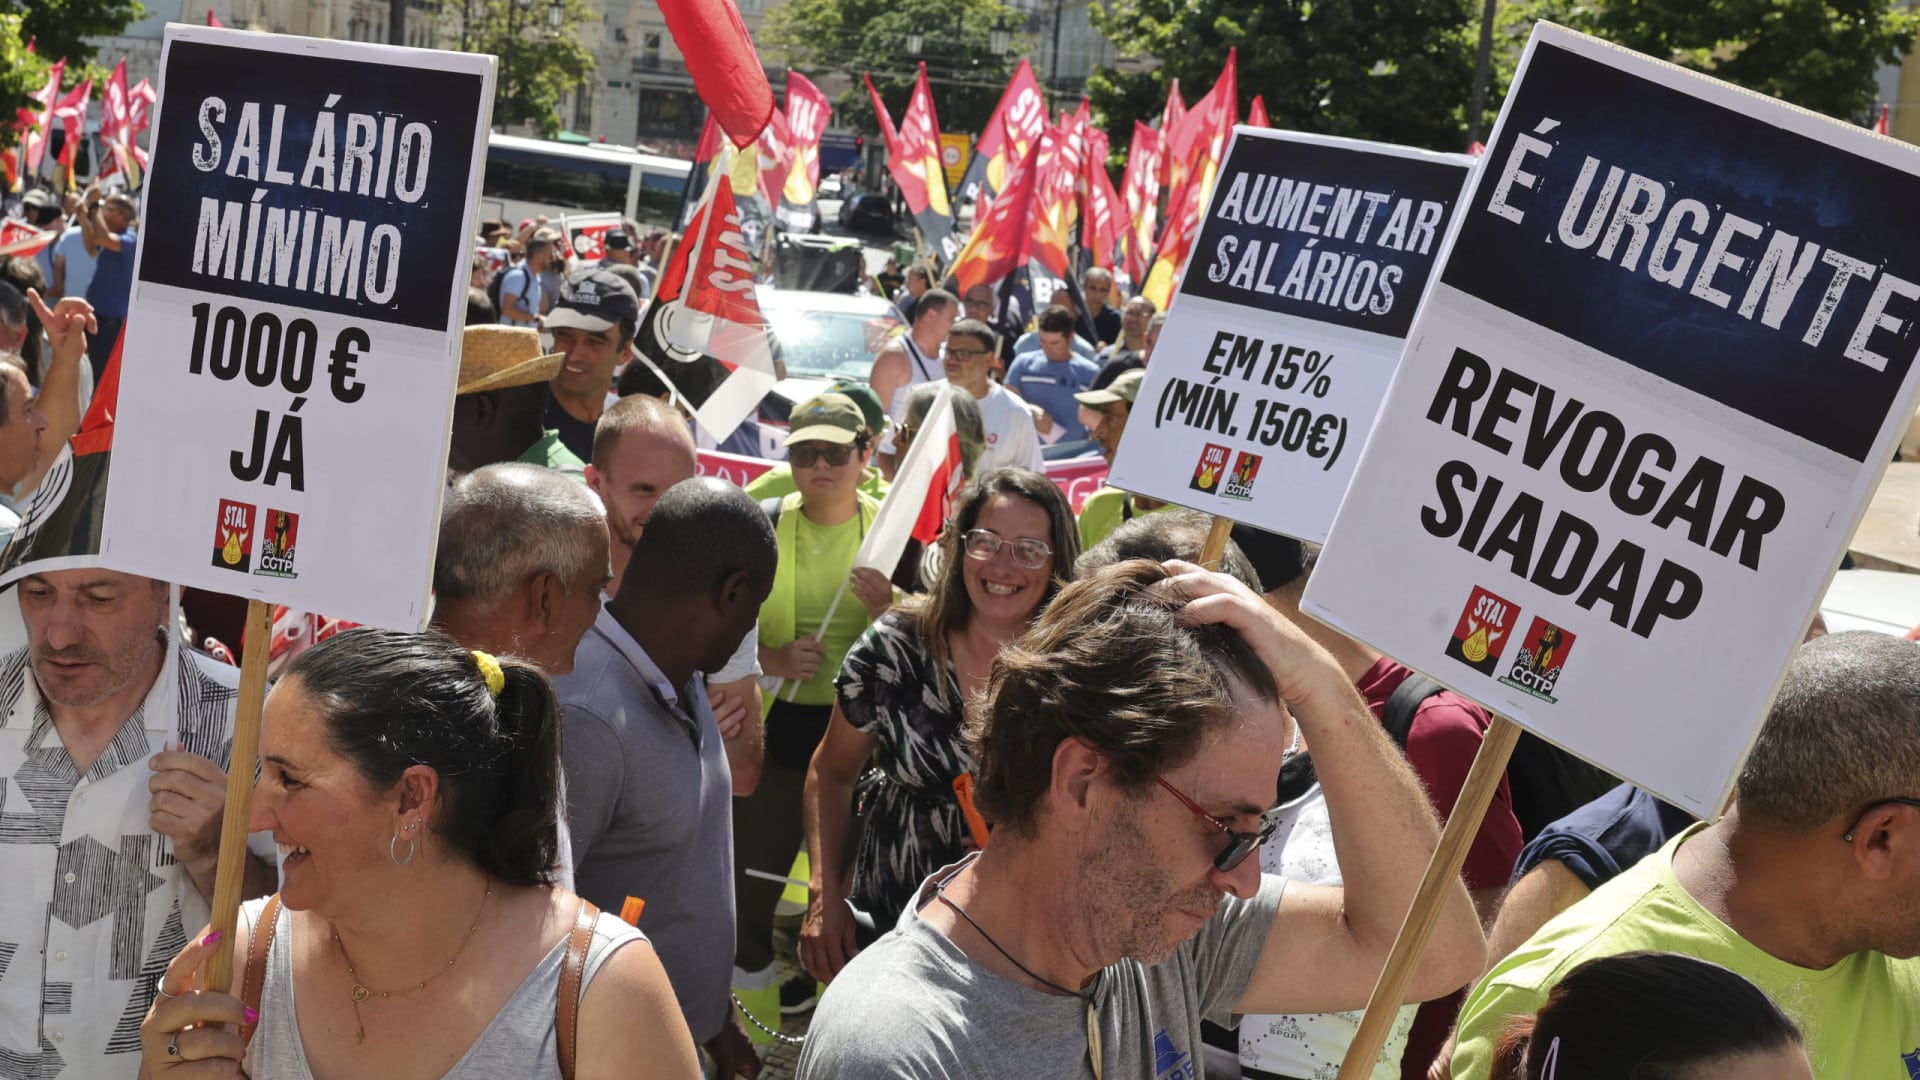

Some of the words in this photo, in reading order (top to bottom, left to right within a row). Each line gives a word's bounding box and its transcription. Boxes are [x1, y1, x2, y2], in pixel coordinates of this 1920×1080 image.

[192, 93, 433, 204] SALÁRIO
[192, 188, 402, 305] MÍNIMO
[1217, 171, 1444, 256] AUMENTAR
[1487, 117, 1562, 225] É
[1556, 155, 1920, 373] URGENTE
[1207, 234, 1403, 316] SALÁRIOS
[189, 302, 318, 394] 1000
[327, 326, 371, 404] €
[1202, 331, 1264, 381] EM
[1261, 343, 1334, 399] 15%
[229, 396, 305, 493] JÁ
[1155, 376, 1239, 437] (MÍN.
[1246, 398, 1348, 472] 150€)
[1205, 447, 1225, 464] STAL
[1425, 346, 1786, 572] REVOGAR
[224, 505, 247, 528] STAL
[1226, 483, 1250, 497] CGTP
[261, 555, 293, 573] CGTP
[1420, 460, 1704, 639] SIADAP
[1473, 595, 1507, 627] STAL
[1511, 665, 1554, 693] CGTP
[1269, 1028, 1304, 1041] SPORT
